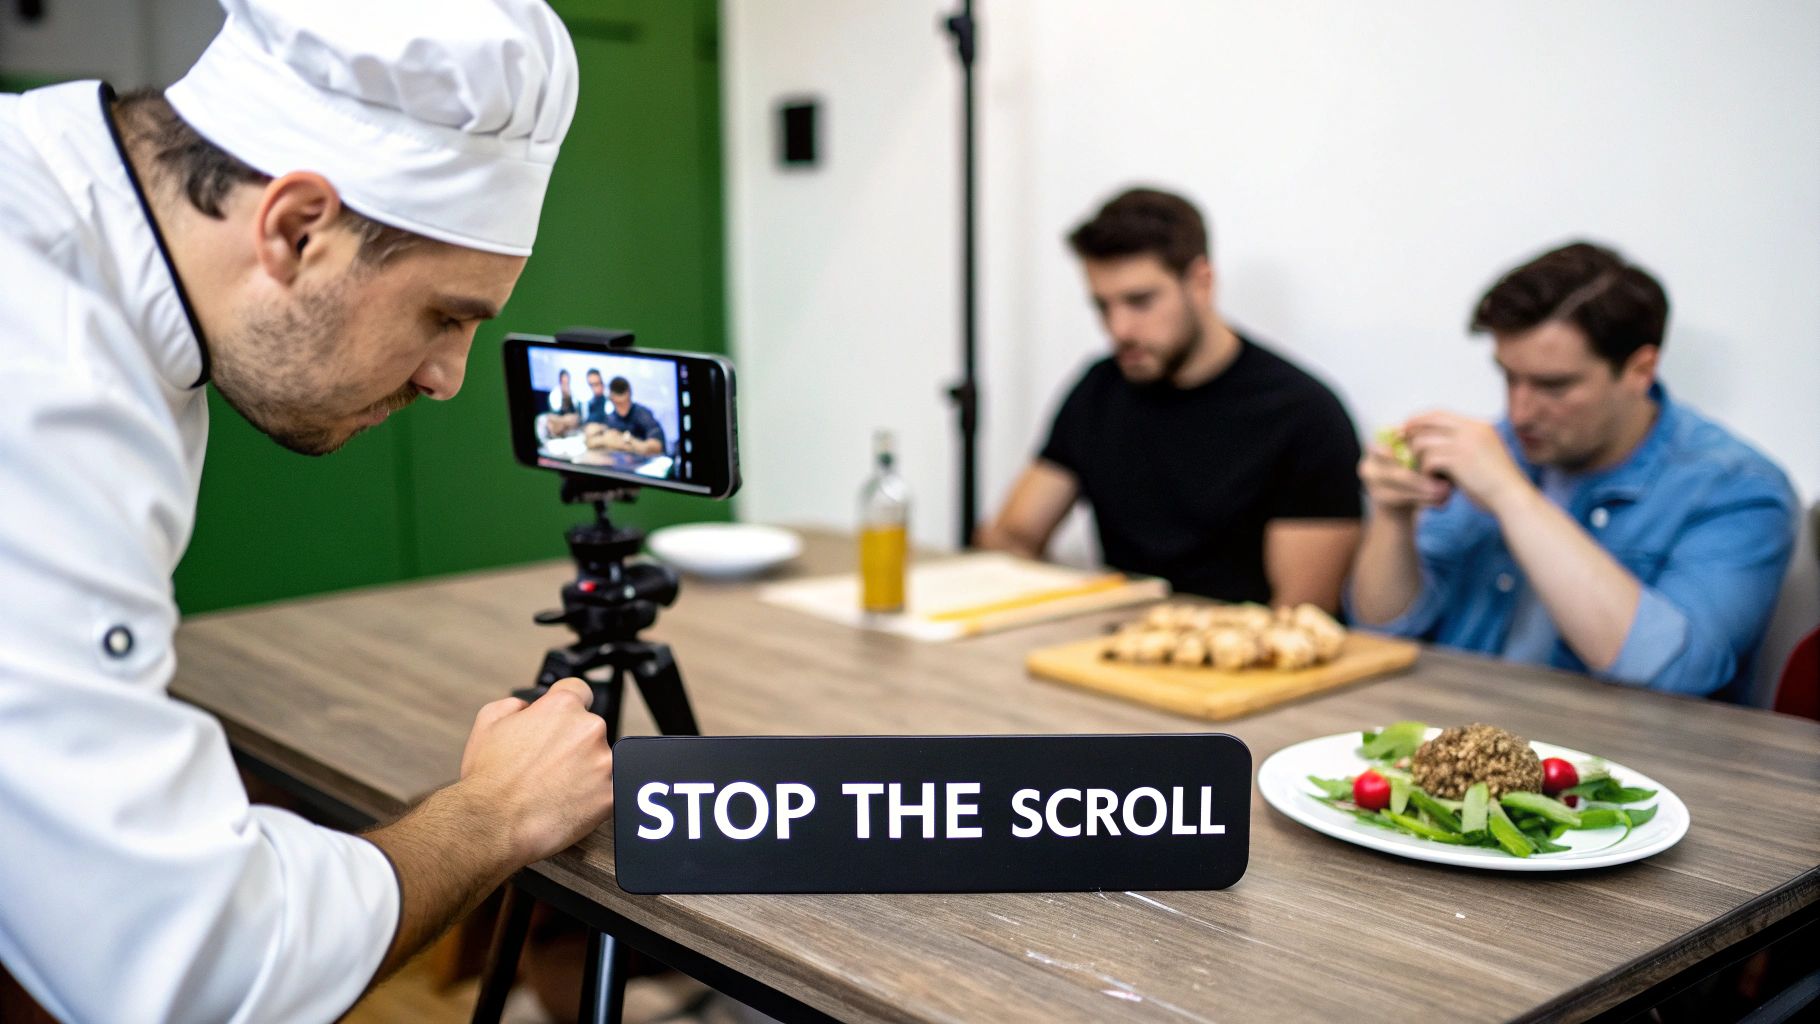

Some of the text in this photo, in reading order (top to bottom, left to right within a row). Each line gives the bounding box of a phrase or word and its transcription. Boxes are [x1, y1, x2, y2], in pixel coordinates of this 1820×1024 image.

[637, 782, 1226, 840] STOP THE SCROLL
